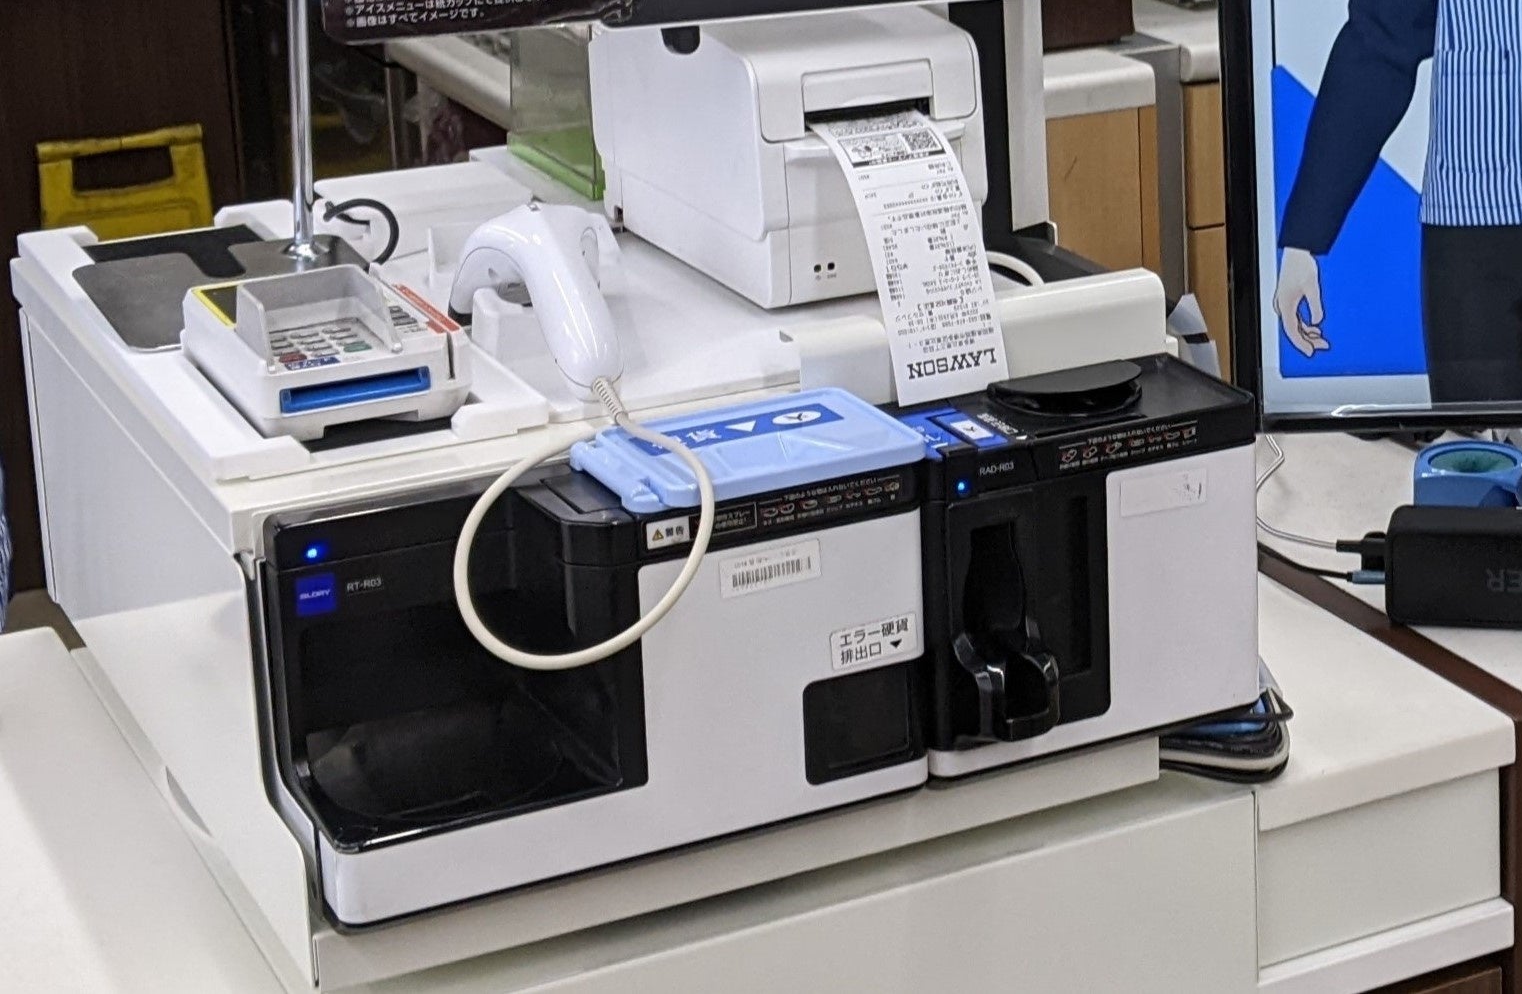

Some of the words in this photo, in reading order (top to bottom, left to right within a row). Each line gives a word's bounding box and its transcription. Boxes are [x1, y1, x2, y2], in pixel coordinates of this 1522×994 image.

[907, 346, 998, 380] LAWSON
[839, 618, 909, 649] エラー硬貨
[839, 640, 882, 666] 排出口
